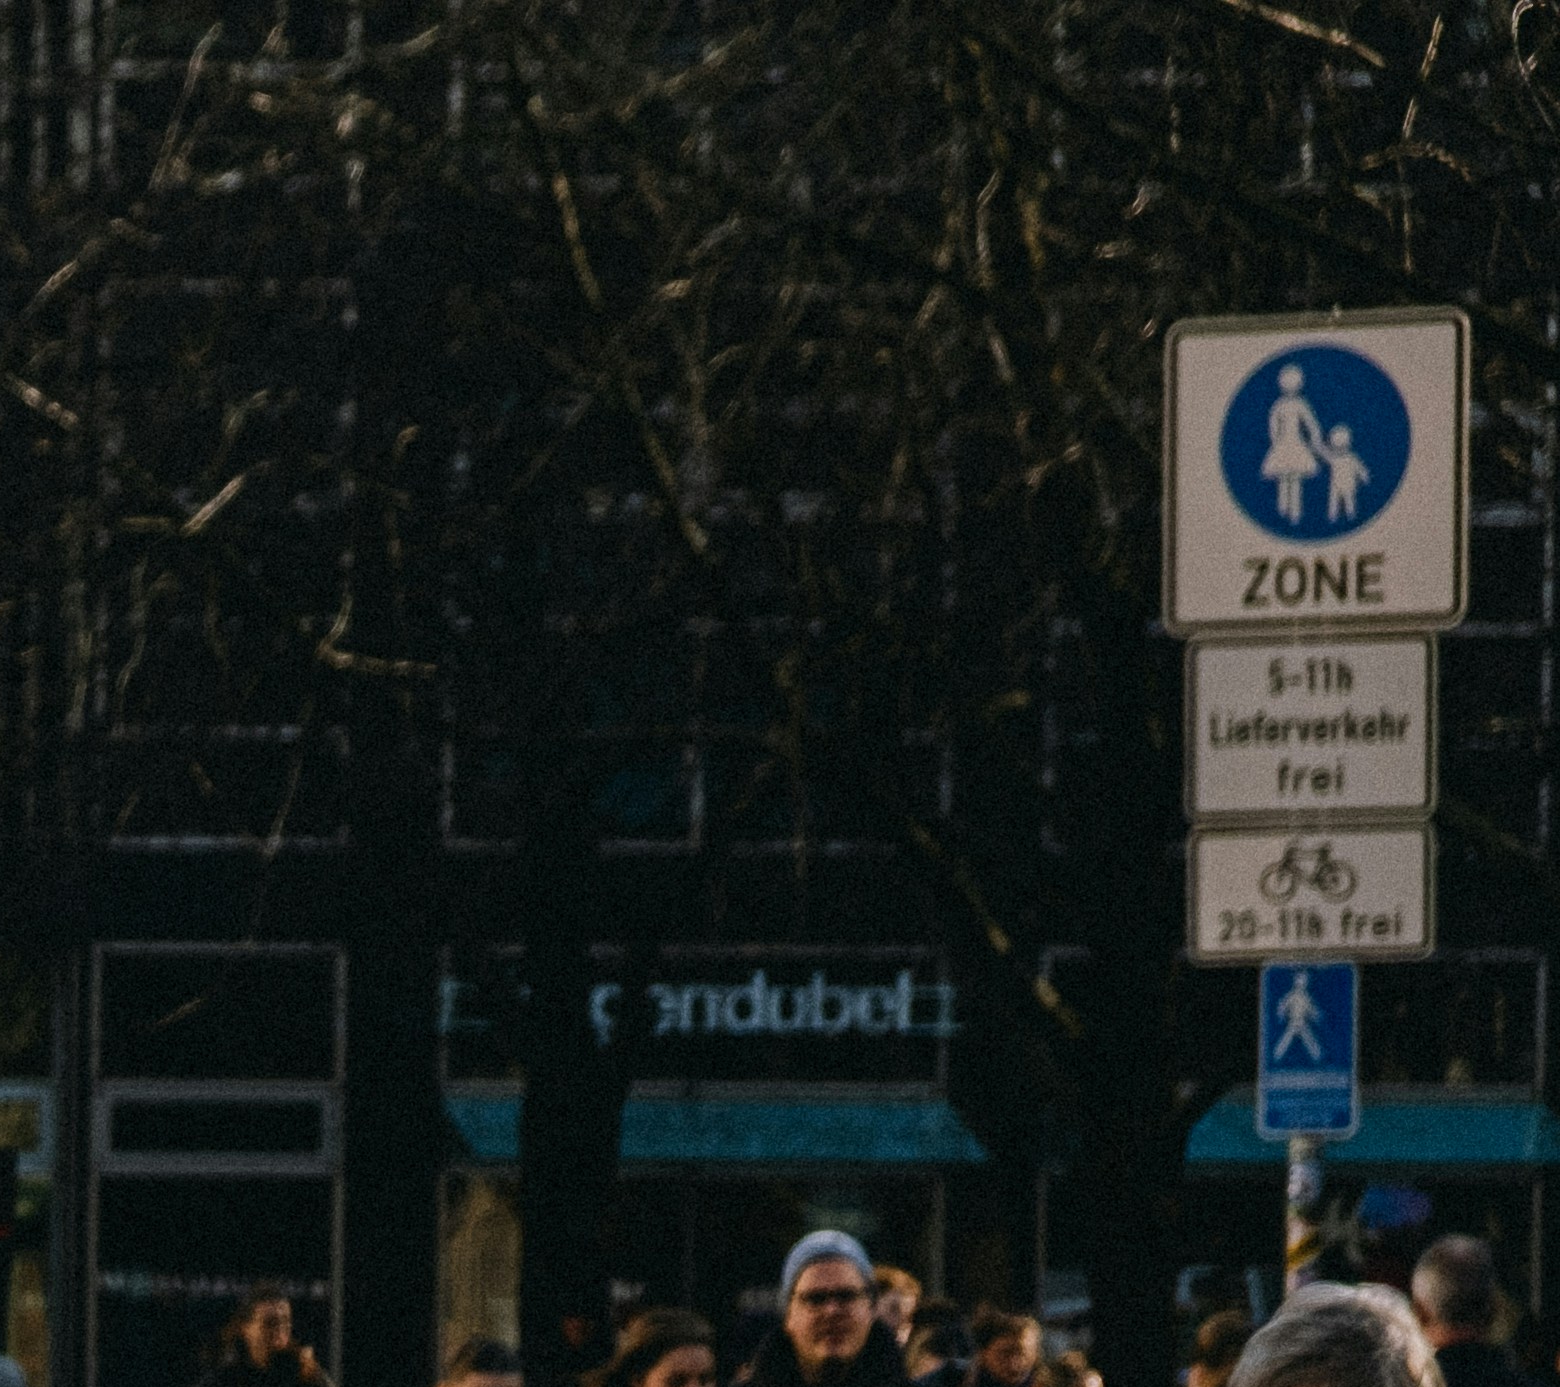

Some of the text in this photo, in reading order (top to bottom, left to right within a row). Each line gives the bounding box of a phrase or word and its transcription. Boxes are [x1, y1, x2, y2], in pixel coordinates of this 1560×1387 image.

[1240, 553, 1386, 612] ZONE
[1267, 657, 1353, 695] 5-11h
[1208, 706, 1410, 747] Lieferverkehr
[1276, 757, 1346, 796] frei
[1339, 907, 1403, 940] frei
